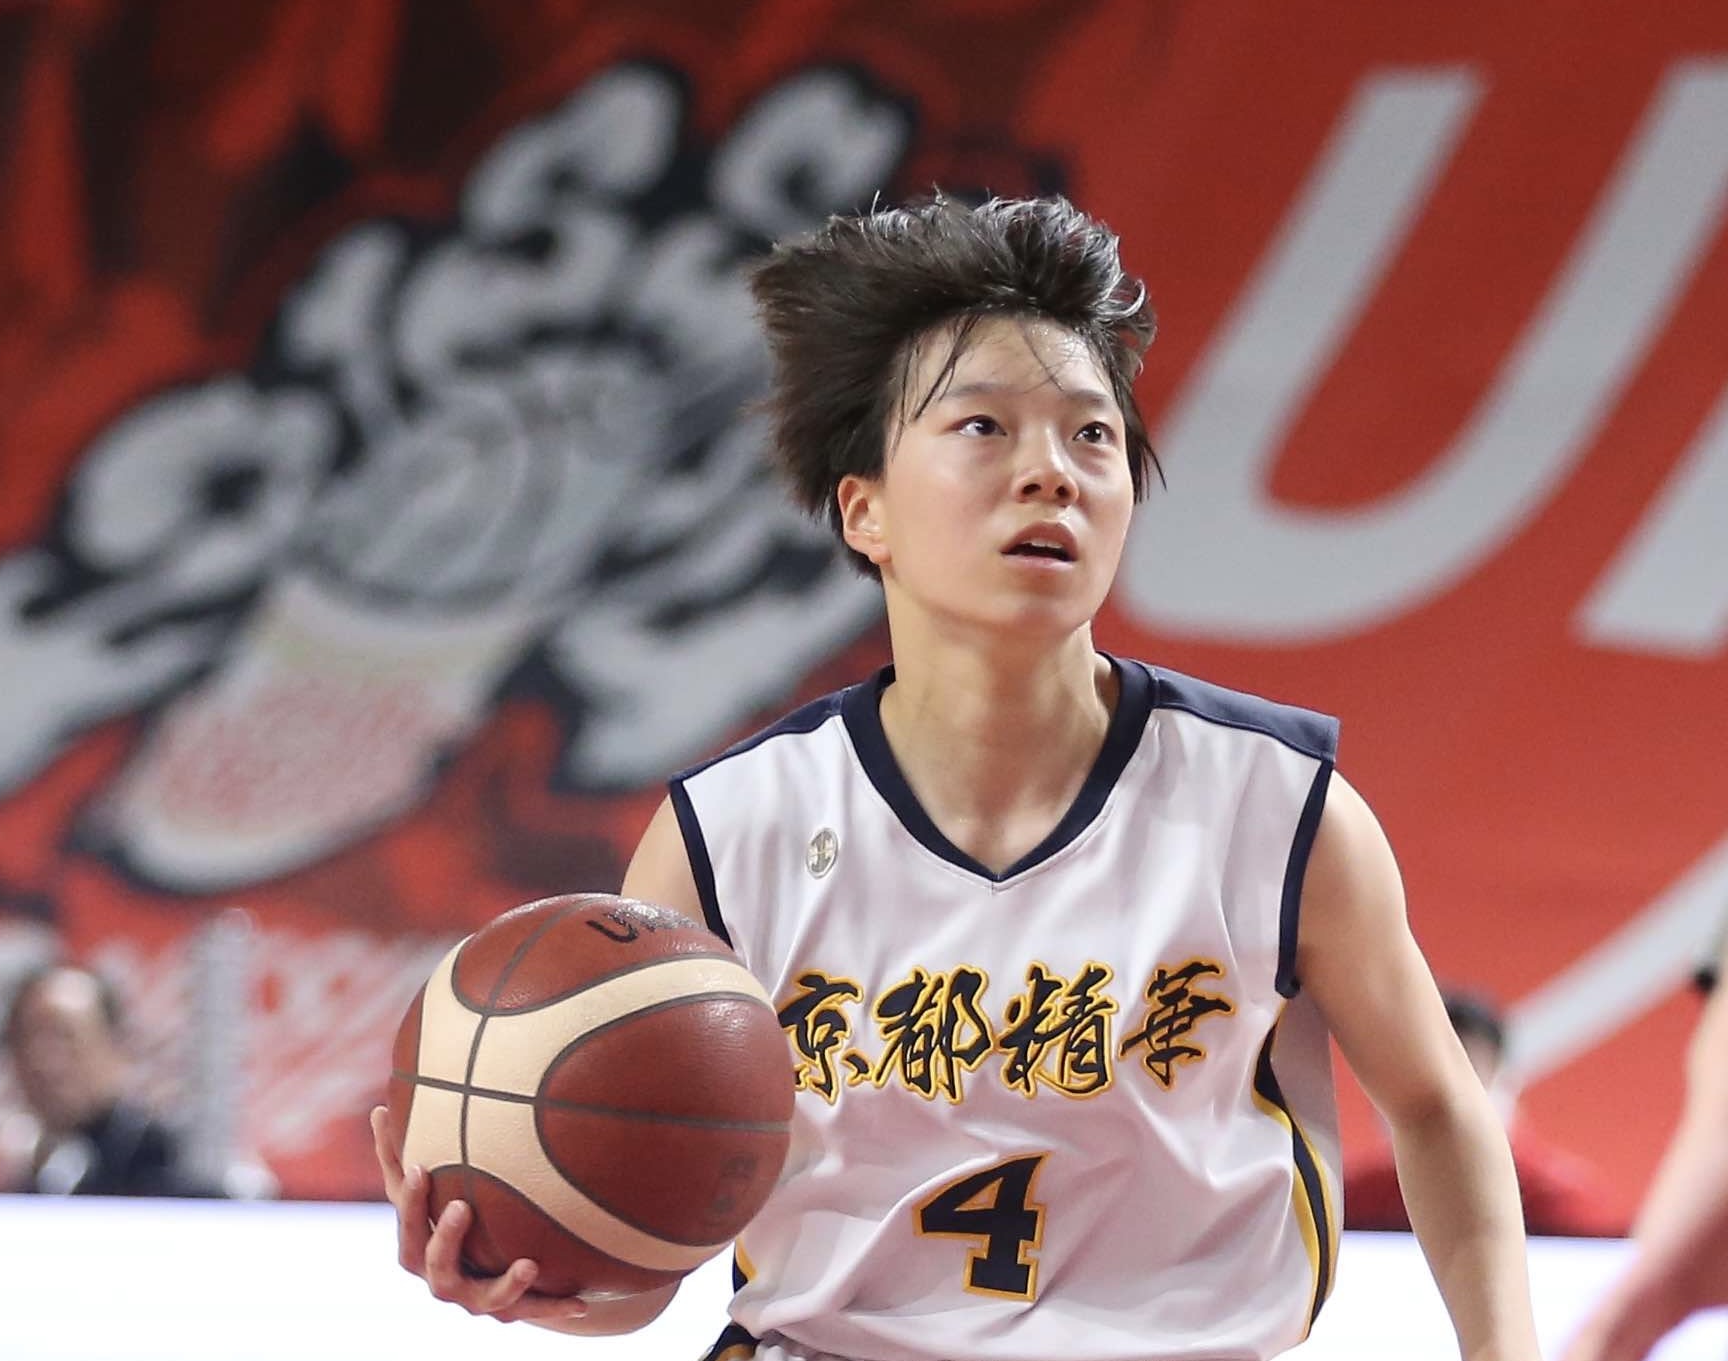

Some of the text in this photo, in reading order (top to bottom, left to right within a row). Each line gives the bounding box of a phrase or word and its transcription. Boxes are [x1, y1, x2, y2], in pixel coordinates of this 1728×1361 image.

[776, 955, 1236, 1106] 京都精華
[913, 1150, 1048, 1302] 4
